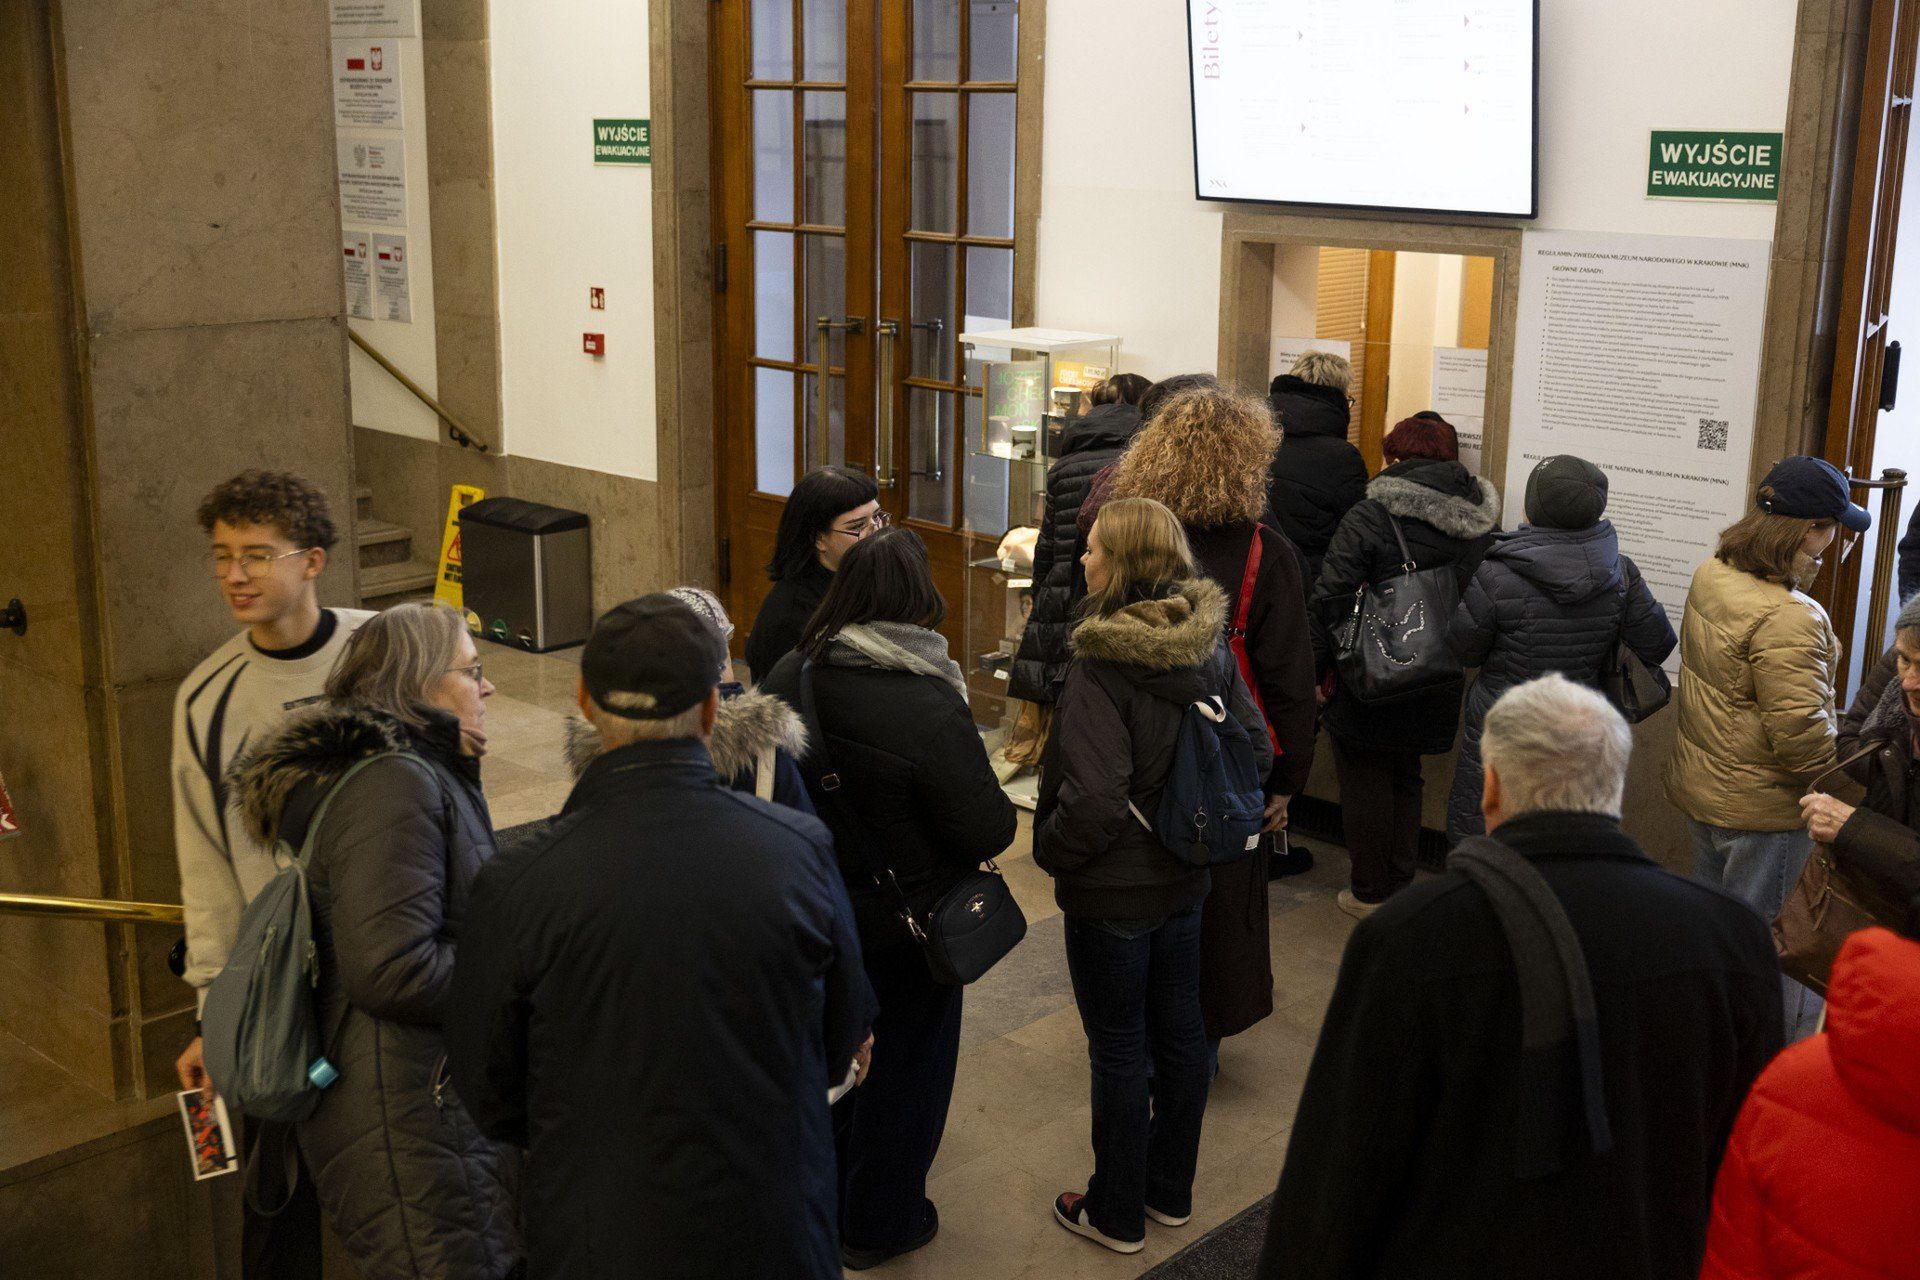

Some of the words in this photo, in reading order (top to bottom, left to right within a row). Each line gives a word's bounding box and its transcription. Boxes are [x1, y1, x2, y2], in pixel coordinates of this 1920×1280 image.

[1202, 1, 1222, 79] Bilety
[598, 123, 648, 141] WYJŚCIE
[596, 145, 650, 156] EWAKUACYJNE
[1660, 139, 1772, 166] WYJŚCIE
[1651, 170, 1775, 189] EWAKUACYJNE
[1639, 256, 1686, 264] NARODOWEGO
[1694, 259, 1728, 267] KRAKOWIE
[1615, 465, 1644, 474] NATIONAL
[1646, 469, 1672, 477] MUSEUM
[1710, 477, 1730, 486] (MNK)
